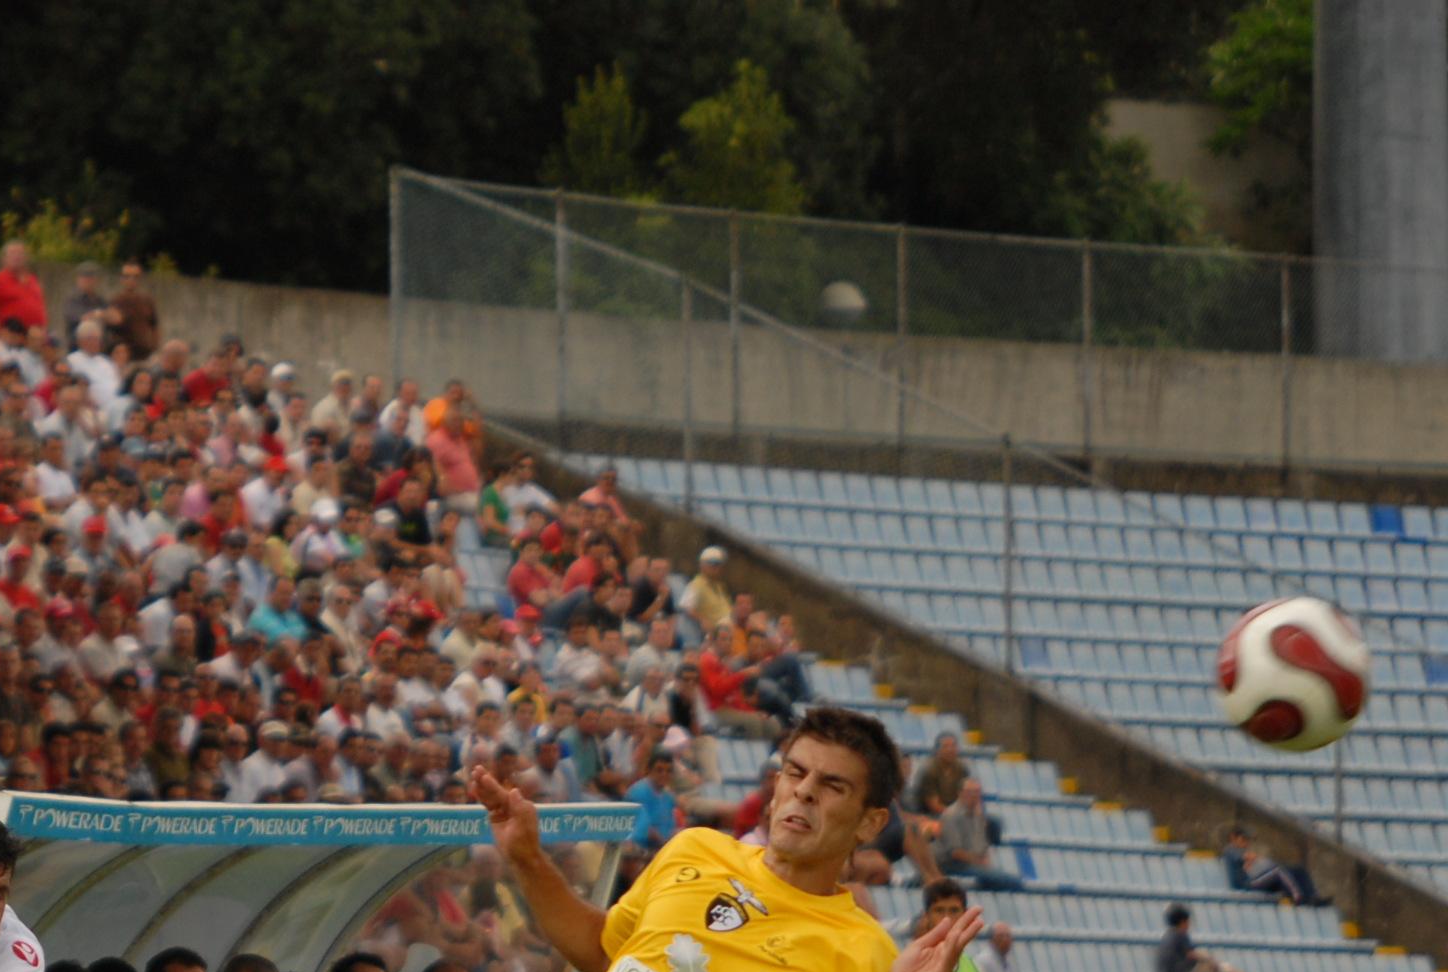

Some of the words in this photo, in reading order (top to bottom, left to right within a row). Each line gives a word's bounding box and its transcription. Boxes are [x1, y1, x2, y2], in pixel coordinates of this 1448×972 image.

[32, 807, 123, 833] POWERADE
[140, 815, 218, 835] POWERADE
[234, 815, 308, 836] POWERADE
[323, 816, 395, 836] POWERADE
[411, 817, 481, 836] POWERADE
[572, 814, 635, 833] POWERADE
